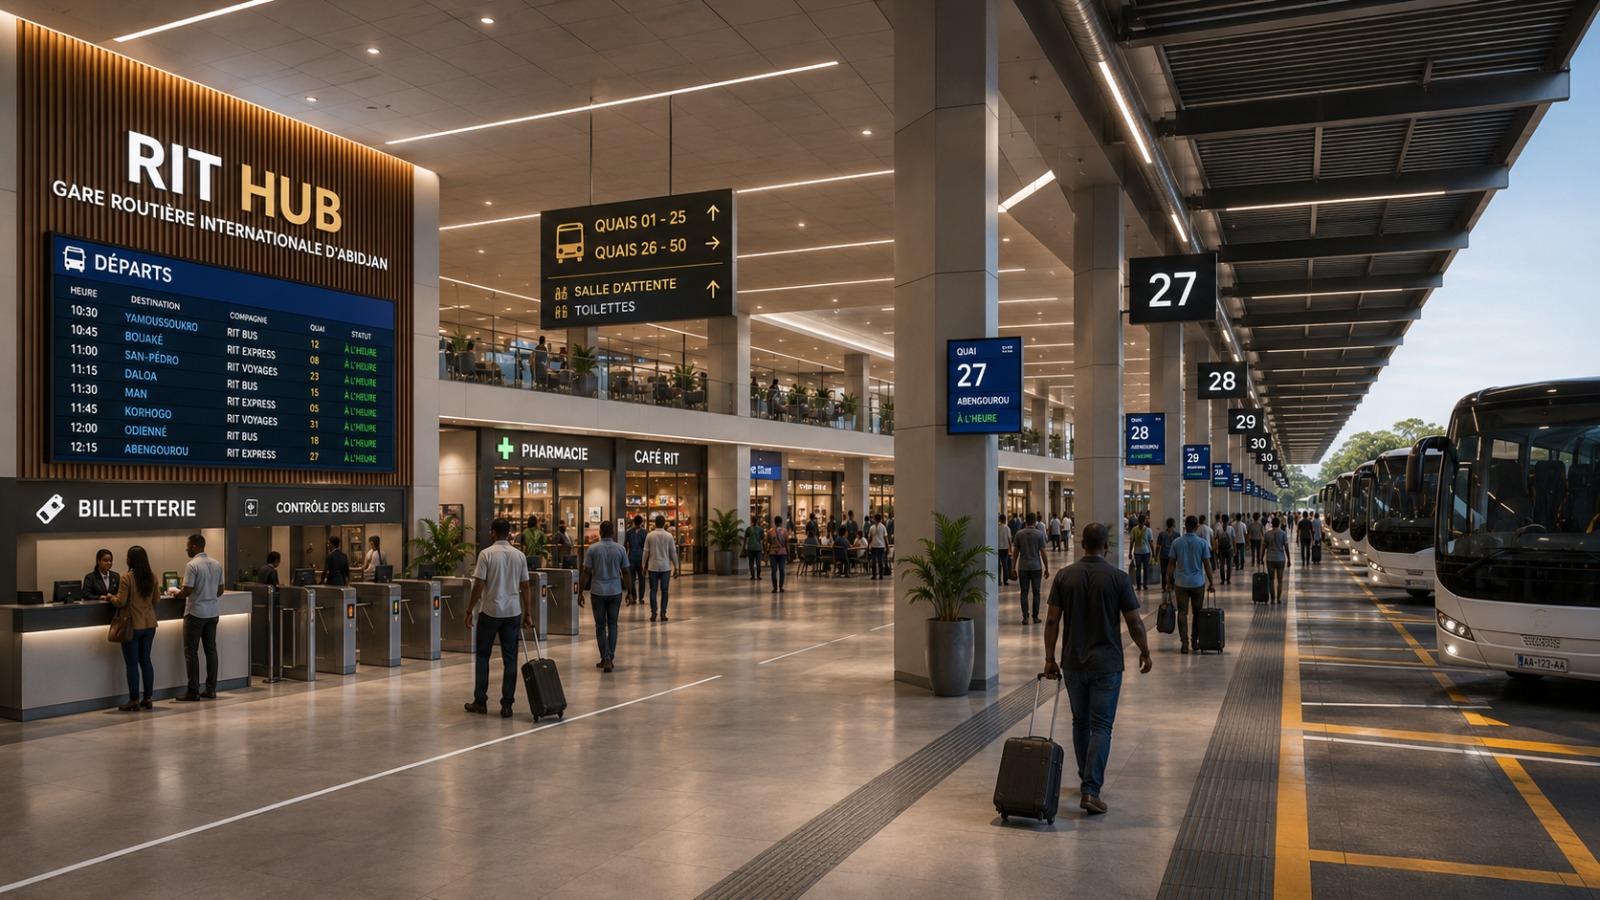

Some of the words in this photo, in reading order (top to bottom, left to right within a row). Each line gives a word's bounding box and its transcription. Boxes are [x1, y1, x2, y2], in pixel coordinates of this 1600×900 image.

[128, 130, 222, 202] RIT
[241, 163, 342, 233] HUB
[53, 180, 105, 206] GARE
[111, 193, 195, 227] ROUTIÈRE
[200, 214, 322, 256] INTERNATIONALE
[326, 244, 388, 271] D'ABIDJAN
[595, 215, 637, 233] QUAIS
[641, 213, 657, 228] 01
[669, 210, 686, 225] 25
[595, 242, 637, 260] QUAIS
[641, 241, 657, 256] 26
[669, 238, 687, 253] 50
[94, 253, 172, 283] DÉPARTS
[574, 283, 609, 297] SALLE
[613, 278, 677, 293] D'ATTENTE
[1148, 271, 1197, 308] 27
[70, 286, 97, 297] HEURE
[131, 296, 180, 310] DESTINATION
[230, 312, 267, 324] COMPAGNIE
[310, 324, 325, 332] QUAI
[352, 331, 371, 339] STATUT
[574, 301, 636, 316] TOILETTES
[71, 305, 97, 317] 10:30
[125, 313, 198, 331] YAMOUSSOUKRO
[227, 328, 240, 337] RIT
[242, 330, 258, 340] BUS
[310, 340, 319, 349] 12
[350, 346, 377, 357] L'HEURE
[71, 325, 97, 337] 10:45
[125, 331, 163, 345] BOUAKÉ
[227, 345, 240, 354] RIT
[242, 347, 276, 359] EXPRESS
[350, 361, 377, 372] L'HEURE
[956, 347, 977, 356] QUAI
[71, 344, 97, 356] 11:00
[125, 350, 179, 365] SAN-PÉDRO
[227, 362, 240, 372] RIT
[242, 364, 278, 376] VOYAGES
[310, 372, 319, 381] 23
[350, 376, 377, 387] L'HEURE
[957, 363, 987, 387] 27
[71, 364, 97, 375] 11:15
[125, 369, 157, 381] DALOA
[227, 380, 240, 389] RIT
[242, 381, 258, 391] BUS
[310, 388, 319, 397] 15
[350, 391, 377, 402] L'HEURE
[1208, 371, 1236, 391] 28
[71, 383, 97, 394] 11:30
[125, 388, 147, 398] MAN
[227, 397, 240, 406] RIT
[242, 398, 276, 409] EXPRESS
[310, 404, 319, 412] 05
[350, 407, 377, 417] L'HEURE
[957, 396, 1010, 406] ABENGOUROU
[71, 403, 97, 413] 11:45
[125, 407, 172, 419] KORHOGO
[227, 414, 240, 423] RIT
[242, 415, 278, 426] VOYAGES
[310, 420, 319, 429] 31
[350, 422, 377, 432] L'HEURE
[957, 412, 964, 423] À
[965, 413, 998, 423] L'HEURE
[1235, 414, 1257, 429] 29
[71, 422, 97, 433] 12:00
[125, 425, 167, 437] ODIENNÉ
[227, 431, 240, 440] RIT
[242, 432, 258, 441] BUS
[310, 436, 319, 445] 18
[350, 438, 377, 448] L'HEURE
[1131, 426, 1149, 440] 28
[1250, 438, 1267, 449] 30
[71, 442, 97, 452] 12:15
[125, 444, 189, 456] ABENGOUROU
[227, 449, 240, 457] RIT
[242, 449, 276, 459] EXPRESS
[310, 452, 319, 461] 27
[350, 454, 377, 463] L'HEURE
[521, 443, 588, 462] PHARMACIE
[634, 447, 661, 465] CAFÉ
[664, 452, 680, 466] RIT
[1187, 453, 1199, 463] 29
[78, 498, 196, 518] BILLETTERIE
[276, 498, 330, 514] CONTRÔLE
[331, 502, 350, 514] DES
[351, 501, 386, 513] BILLETS
[1524, 657, 1565, 670] AA-123-AA
